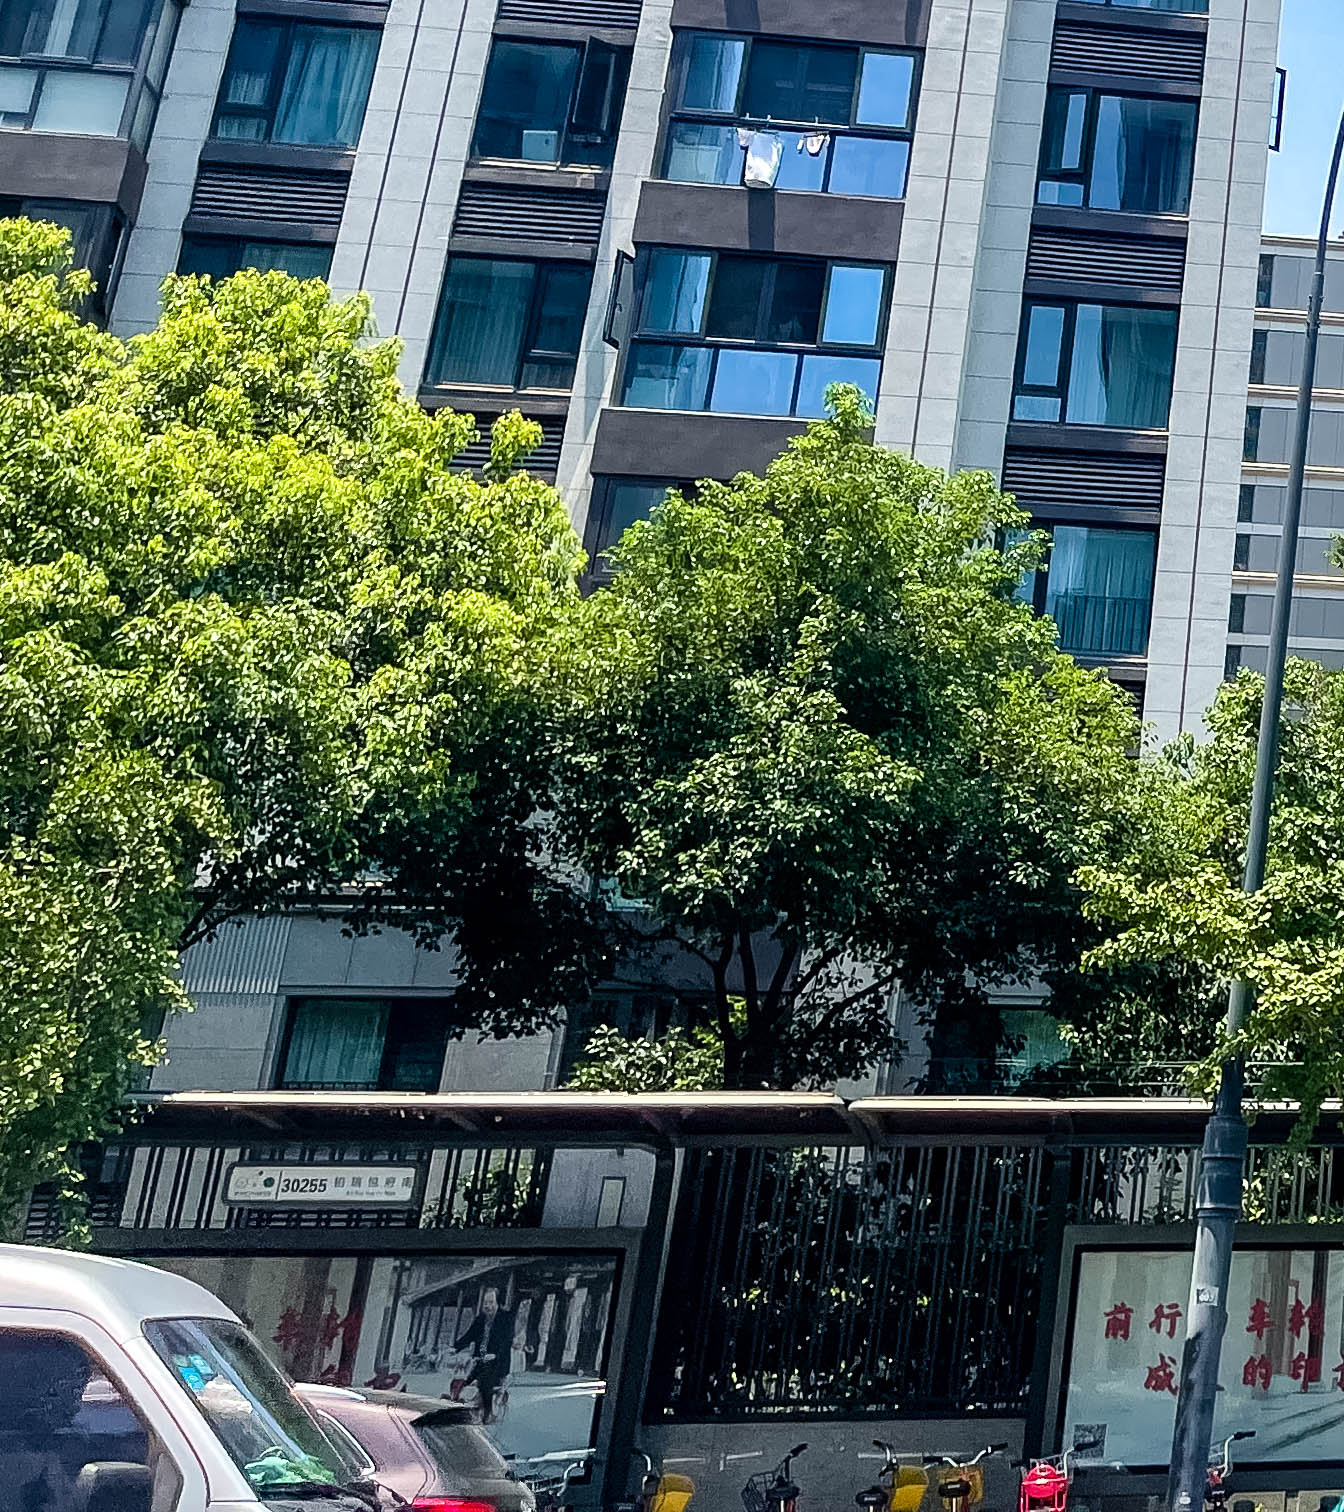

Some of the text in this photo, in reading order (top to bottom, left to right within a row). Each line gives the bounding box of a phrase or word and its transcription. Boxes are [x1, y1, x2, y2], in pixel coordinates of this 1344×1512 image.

[280, 1178, 328, 1193] 30255
[1103, 1298, 1325, 1341] 前行车轮
